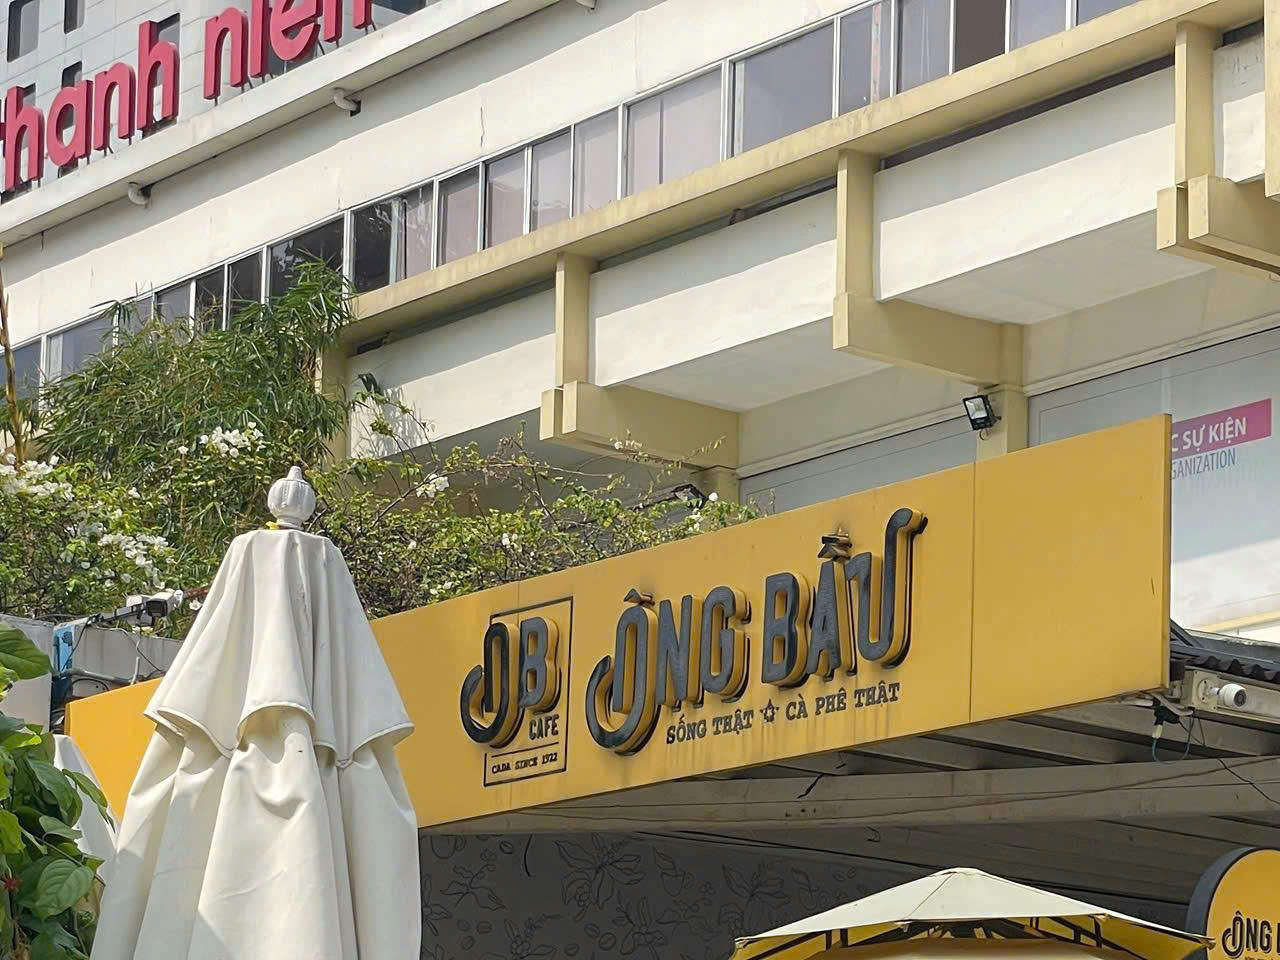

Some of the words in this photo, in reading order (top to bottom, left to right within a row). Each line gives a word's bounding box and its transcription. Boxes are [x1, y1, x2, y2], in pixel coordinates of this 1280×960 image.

[1183, 424, 1205, 451] SỰ
[1209, 417, 1247, 444] KIỆN
[585, 586, 751, 756] ÔNG
[761, 507, 928, 690] BẦU
[666, 714, 707, 744] SỐNG
[712, 708, 754, 735] THẬT
[785, 694, 808, 721] CÀ
[815, 688, 847, 715] PHÊ
[854, 680, 900, 708] THẬT
[1222, 910, 1272, 959] ÔNG
